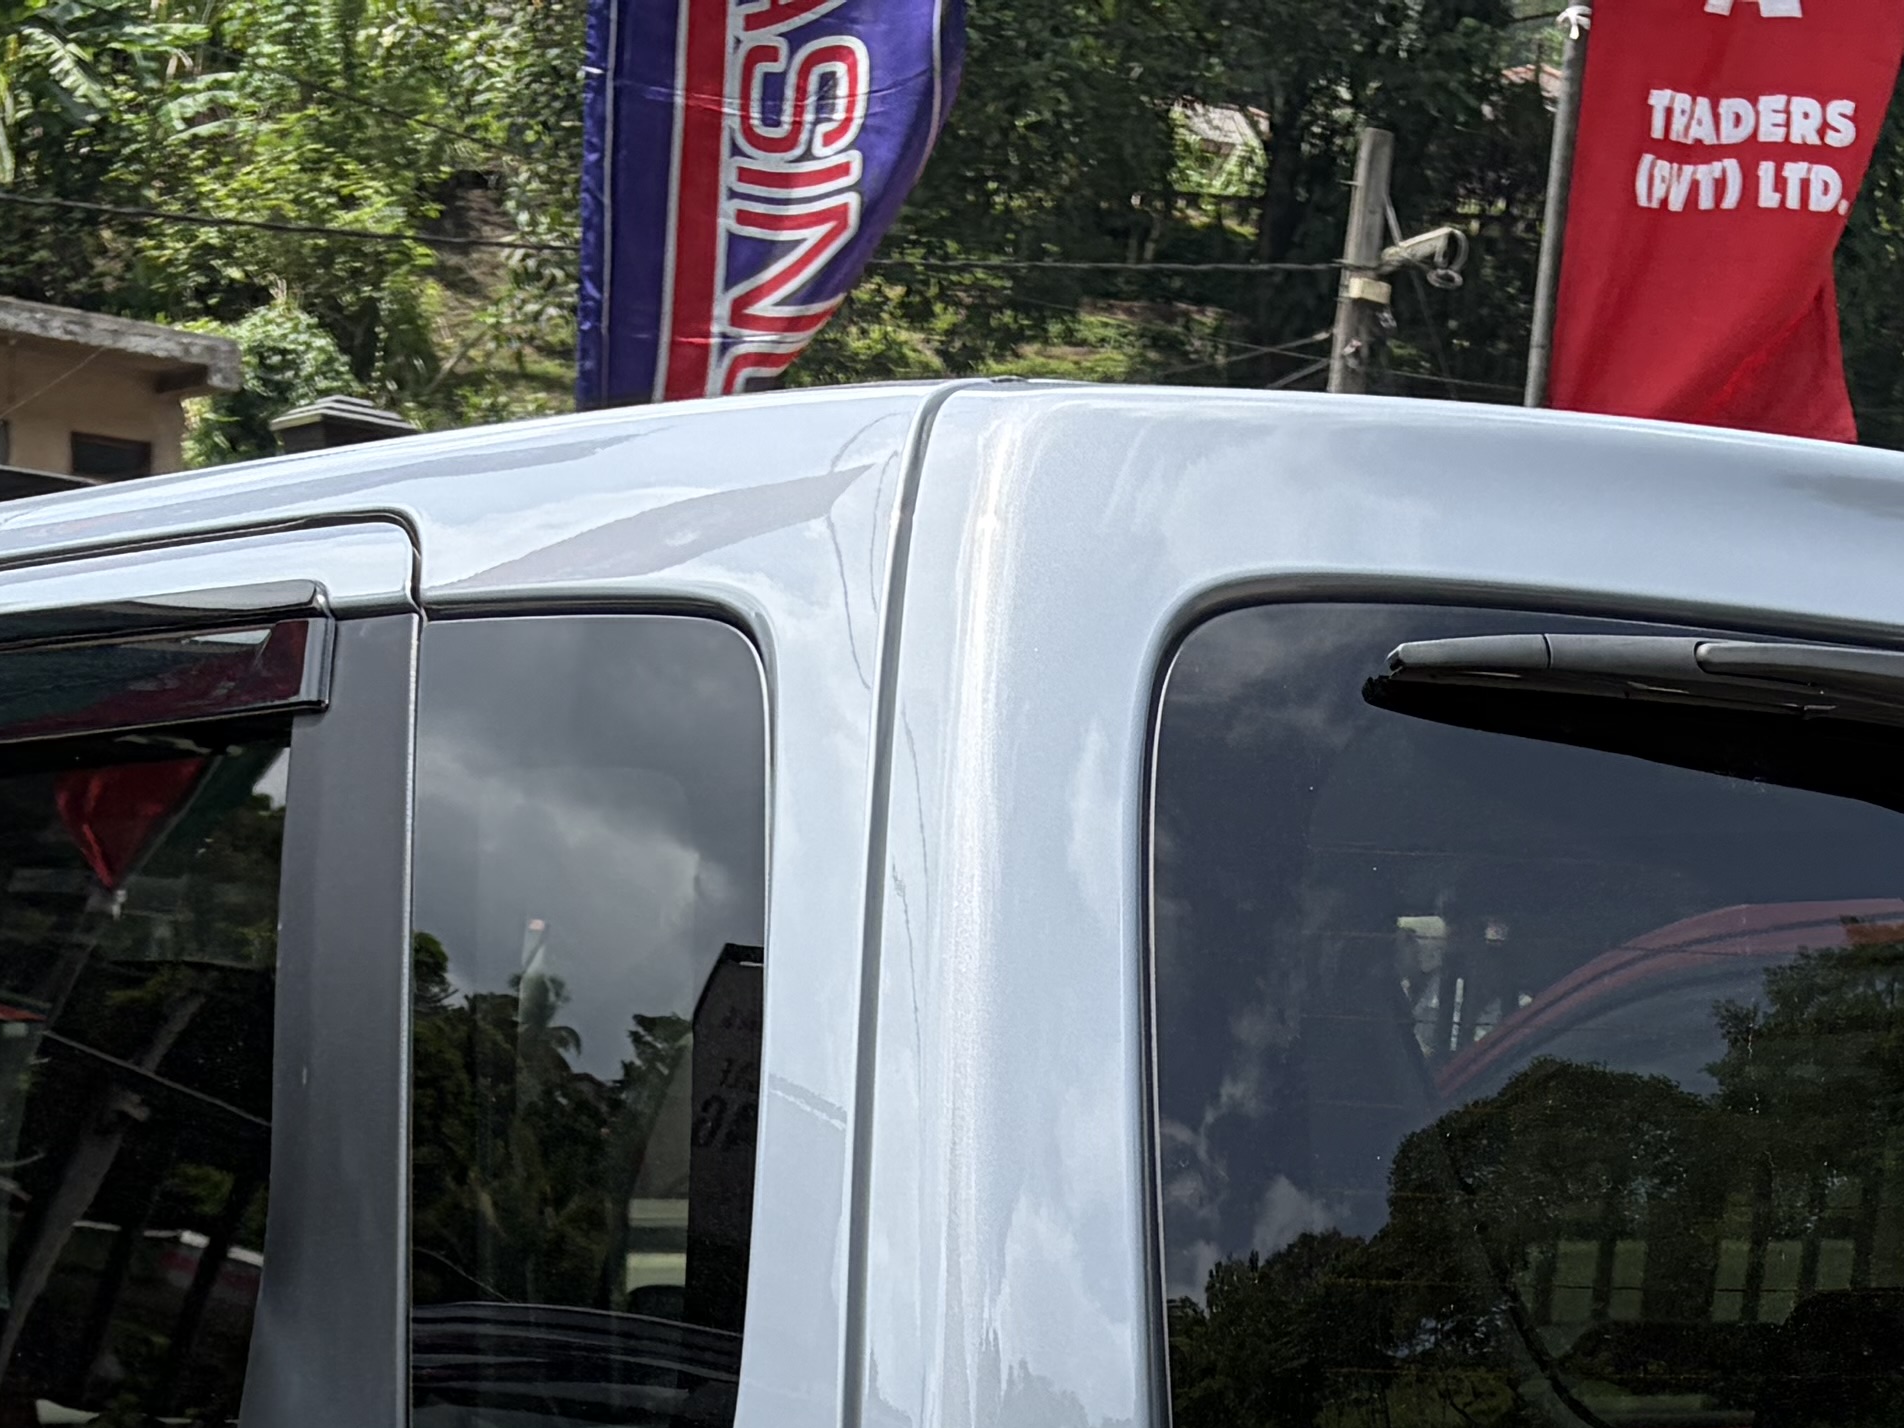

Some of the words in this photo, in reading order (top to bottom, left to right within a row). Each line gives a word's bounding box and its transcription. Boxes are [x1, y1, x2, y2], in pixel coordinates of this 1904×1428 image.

[1647, 88, 1857, 148] TRADERS
[1635, 152, 1743, 212] (PVT)
[1757, 160, 1850, 216] LTD.
